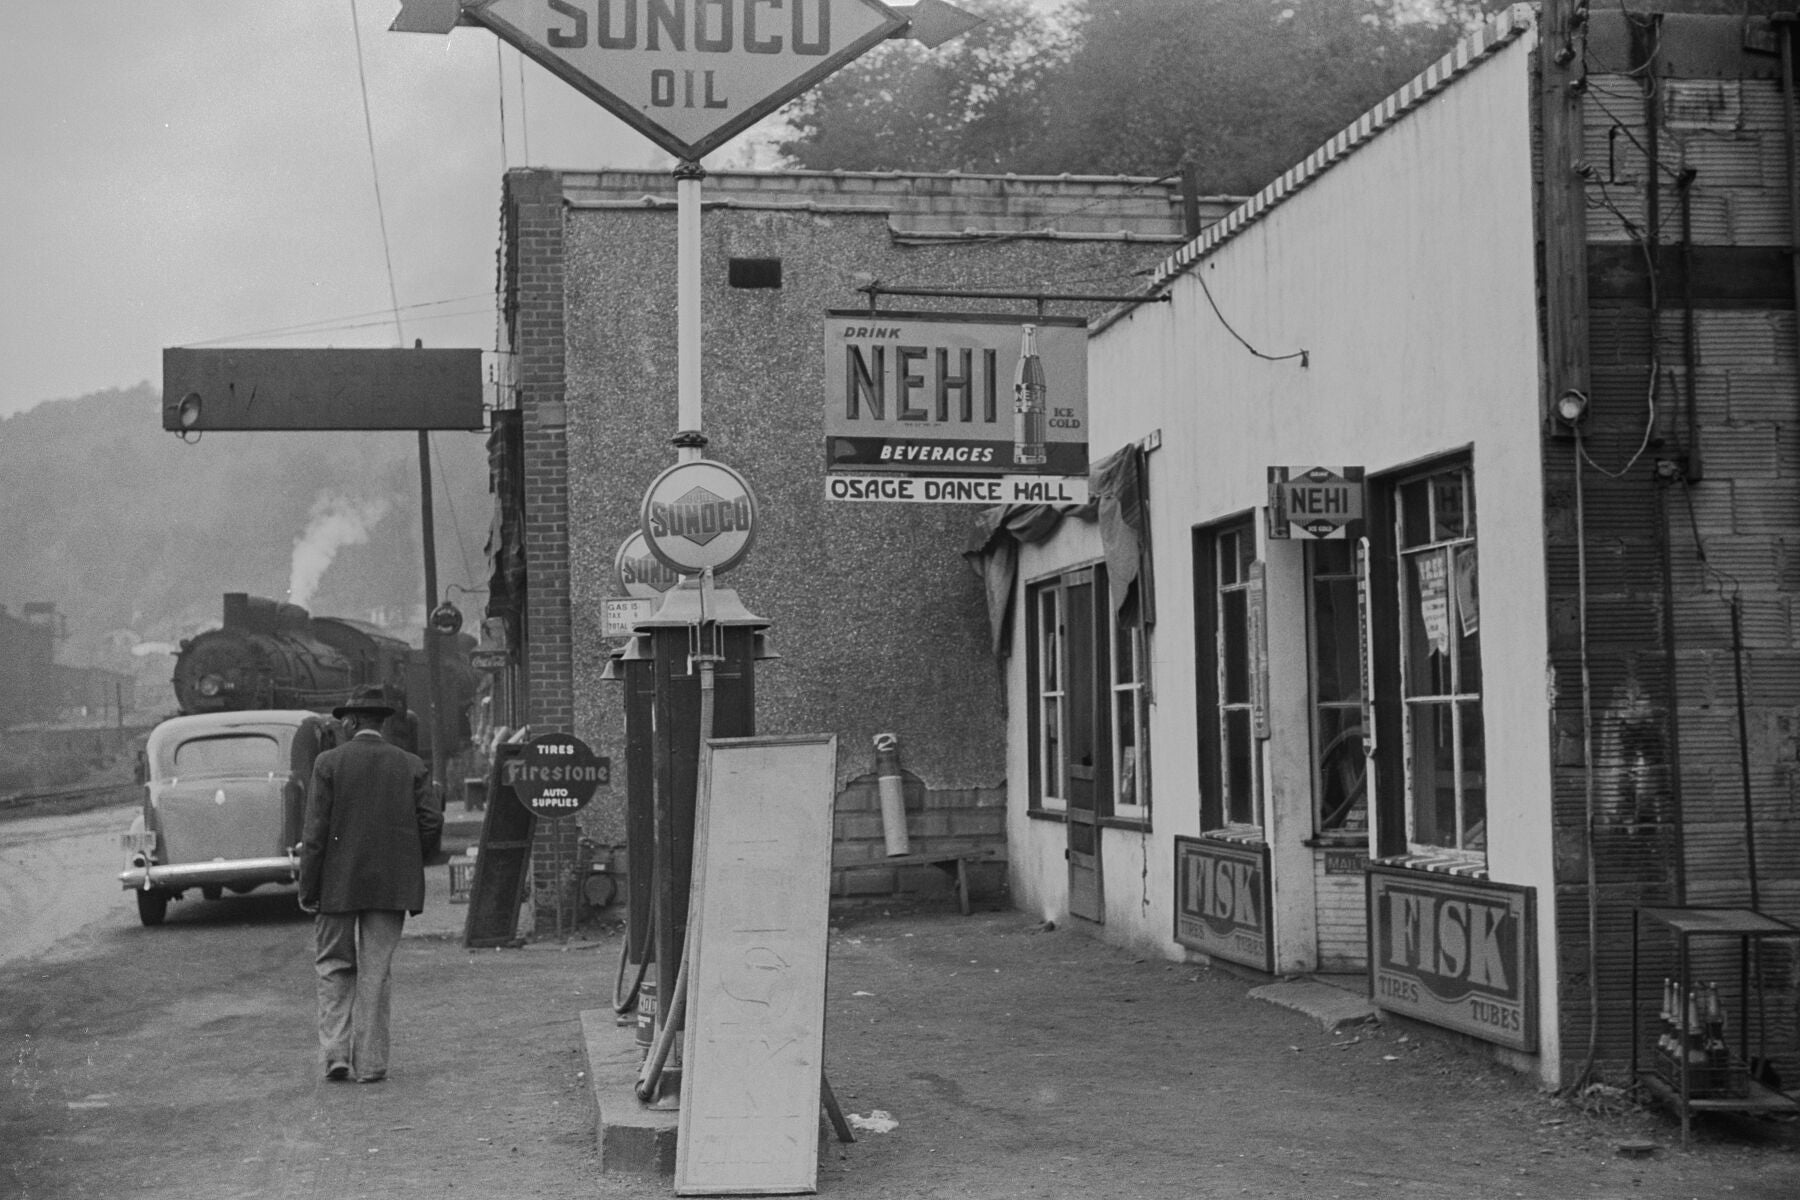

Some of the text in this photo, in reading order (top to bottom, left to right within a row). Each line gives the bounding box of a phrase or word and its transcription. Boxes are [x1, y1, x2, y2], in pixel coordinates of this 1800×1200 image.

[547, 0, 831, 56] SUNOCO
[651, 68, 728, 109] OIL
[844, 326, 901, 339] DRINK
[846, 344, 997, 423] NEHI
[1049, 418, 1081, 429] COLD
[1053, 407, 1075, 418] ICE
[880, 445, 994, 462] BEVERAGES
[831, 479, 1073, 501] OSAGE DANCE HALL
[1291, 487, 1348, 513] NEHI
[651, 494, 750, 538] SUNOCO
[624, 556, 679, 584] SUNO
[607, 603, 628, 611] GAS
[608, 622, 628, 631] TOTAL
[537, 744, 574, 754] TIRES
[503, 759, 608, 783] Firestone
[532, 798, 579, 807] SUPPLIES
[542, 788, 568, 797] AUTO
[1187, 853, 1257, 927] FISK
[1234, 935, 1265, 956] TUBES
[1388, 891, 1509, 990] FISK
[1380, 975, 1419, 1003] TIRES
[1470, 999, 1520, 1031] TUBES
